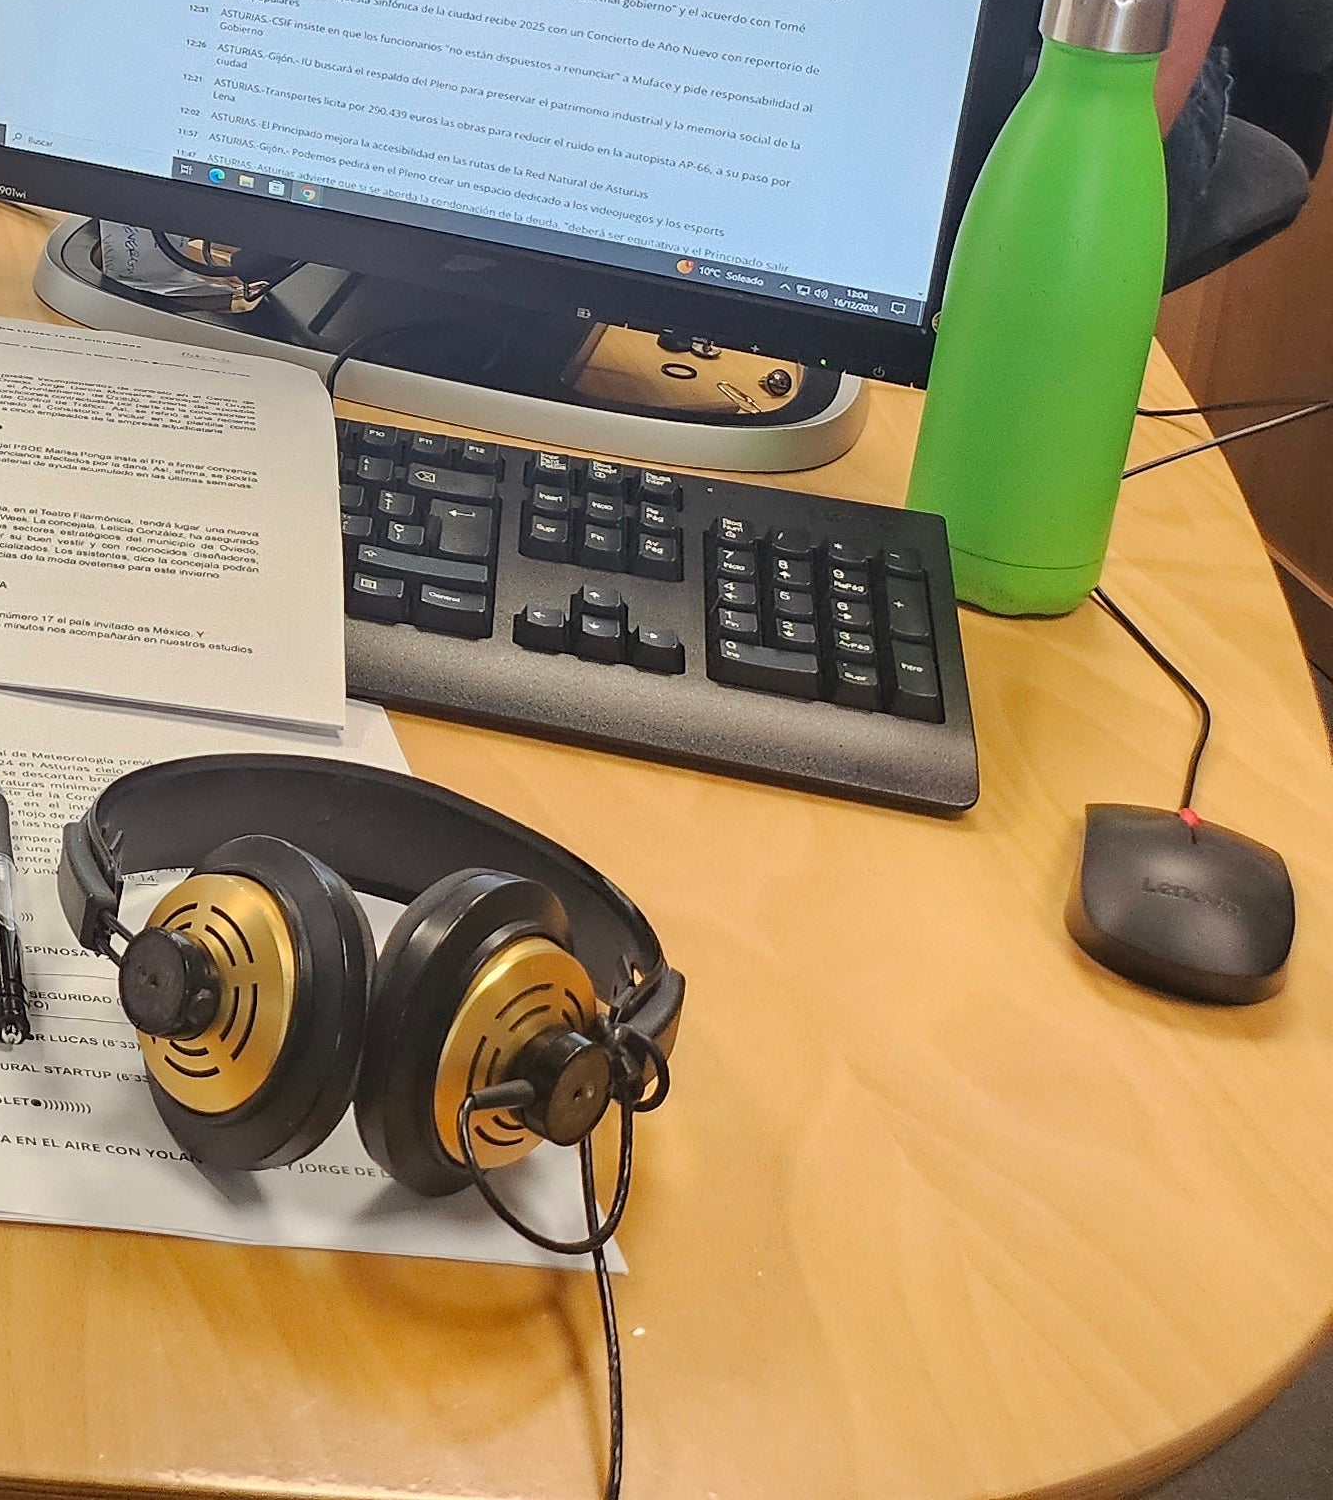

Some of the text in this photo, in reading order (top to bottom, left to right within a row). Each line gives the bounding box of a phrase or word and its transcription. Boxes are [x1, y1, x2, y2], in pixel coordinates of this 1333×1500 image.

[27, 136, 54, 148] Buscar
[725, 271, 764, 287] Soleado
[833, 297, 880, 314] 16/12/2024
[42, 615, 54, 623] 17
[69, 618, 91, 627] país
[93, 620, 135, 632] invitado
[152, 626, 195, 637] México.
[196, 630, 205, 639] Y
[24, 945, 89, 957] SPINOSA
[29, 990, 112, 1004] SEGURIDAD
[49, 1034, 99, 1046] LUCAS
[43, 1065, 112, 1079] STARTUP
[16, 1135, 37, 1146] EN
[42, 1137, 60, 1148] EL
[64, 1140, 101, 1153] AIRE
[105, 1144, 141, 1157] CON
[299, 1163, 375, 1177] JORGE DE
